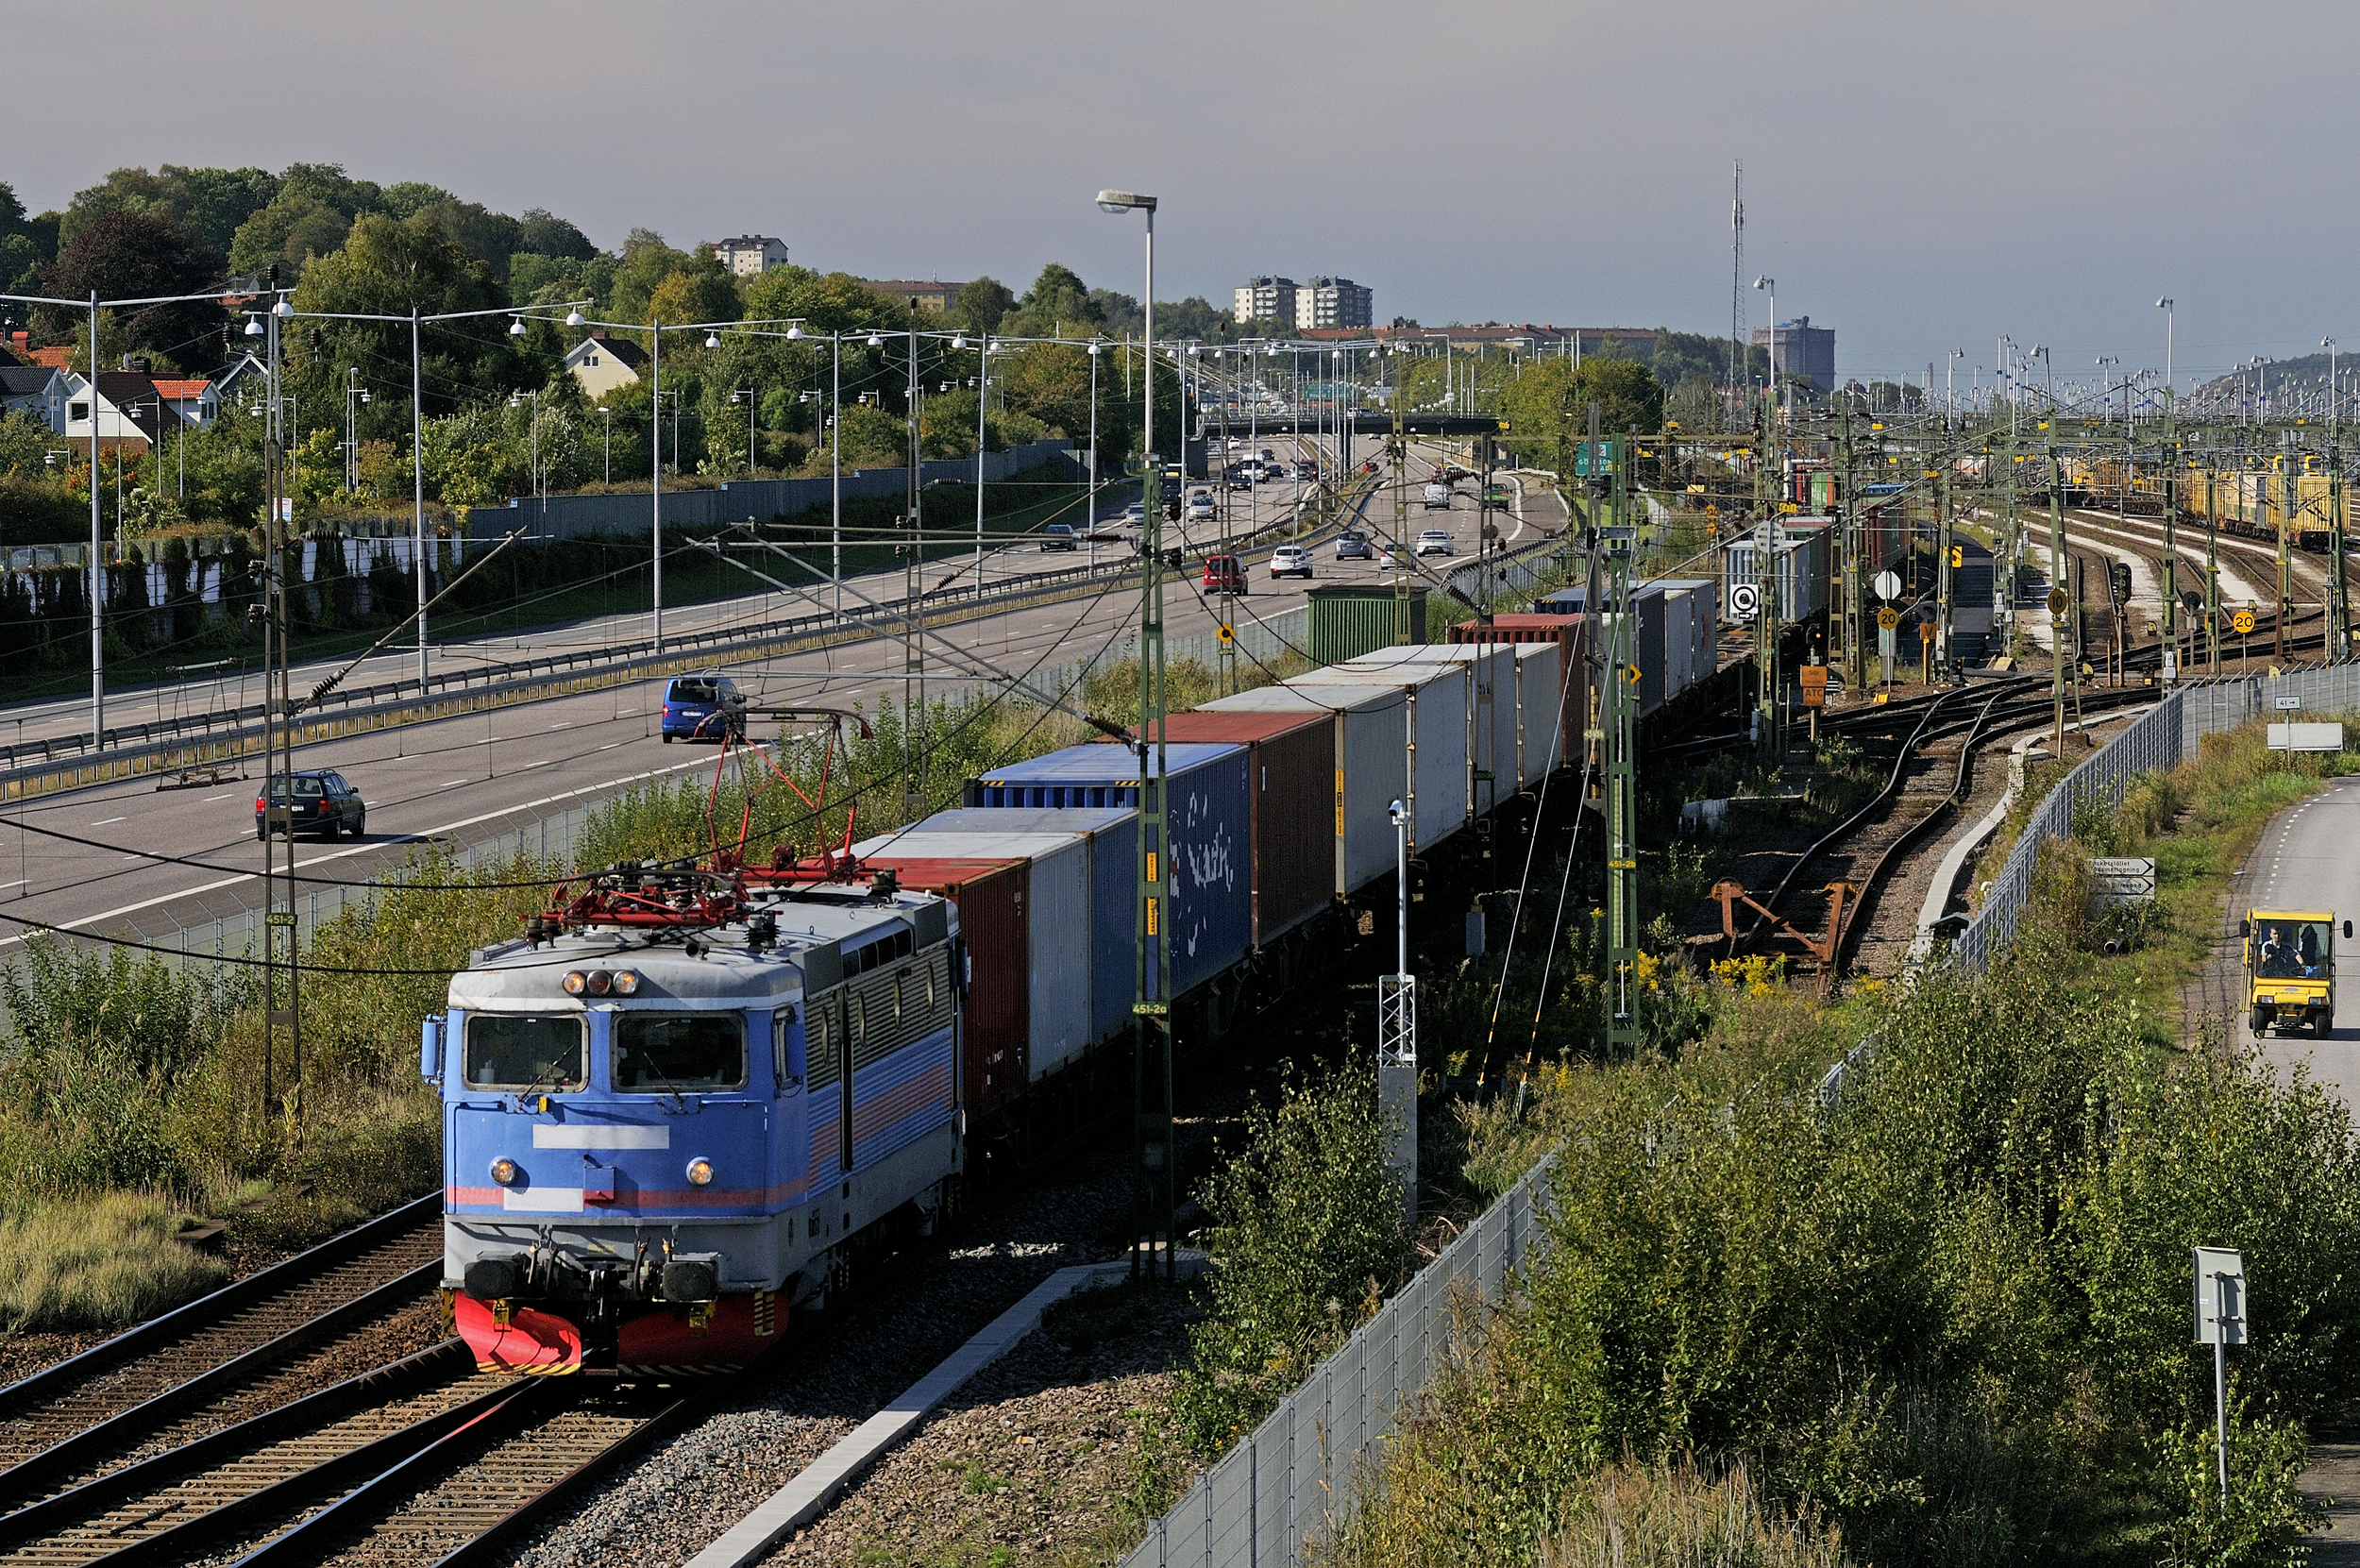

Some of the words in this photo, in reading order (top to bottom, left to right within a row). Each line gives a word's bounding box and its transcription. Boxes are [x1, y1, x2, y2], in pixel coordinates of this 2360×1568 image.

[2052, 596, 2063, 608] 10
[1881, 614, 1896, 625] 20
[2235, 616, 2253, 628] 20
[266, 914, 295, 925] 451-2
[1133, 1003, 1167, 1014] 451-2a
